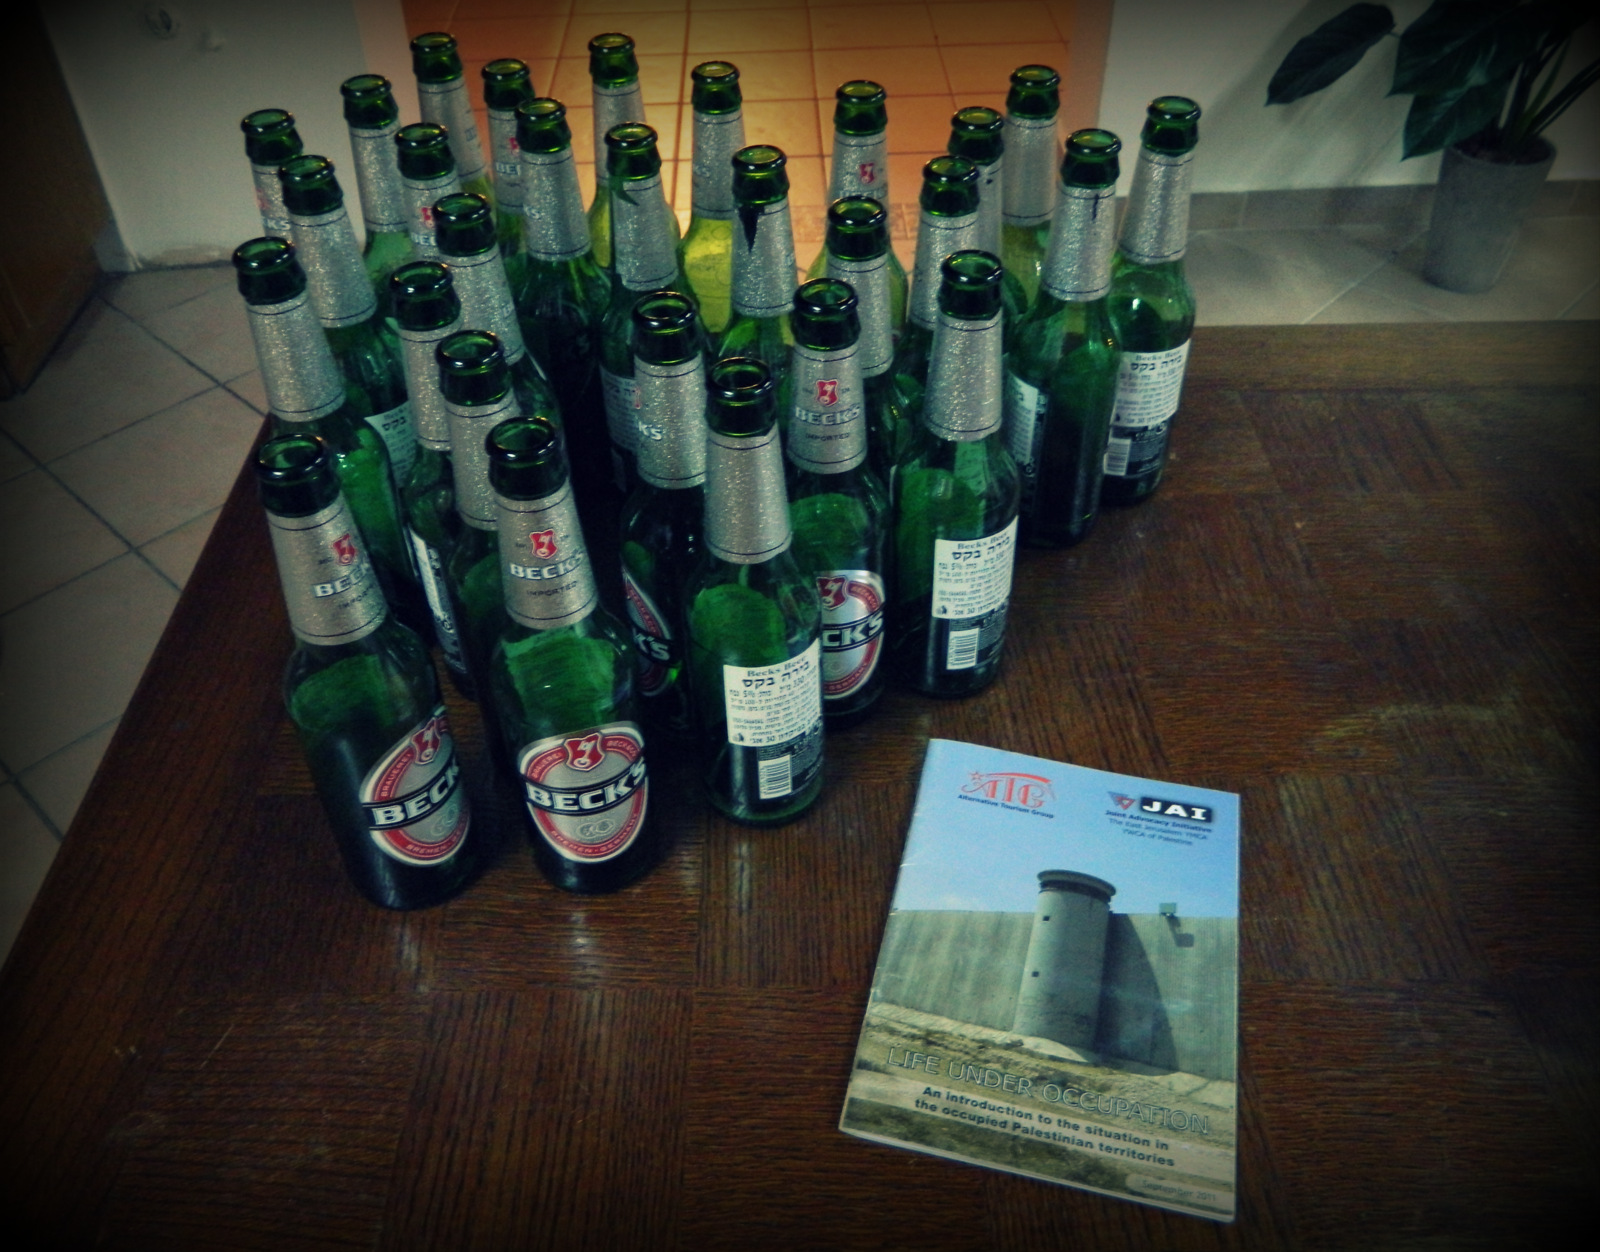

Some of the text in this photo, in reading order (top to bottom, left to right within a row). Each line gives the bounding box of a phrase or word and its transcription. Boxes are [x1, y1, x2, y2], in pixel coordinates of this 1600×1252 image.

[1130, 362, 1156, 373] בקס
[638, 421, 662, 441] K'S
[951, 535, 1011, 562] בירה בקס
[957, 542, 987, 550] Becks
[509, 546, 585, 580] BECK'S
[526, 580, 578, 597] IMPORTED
[821, 611, 885, 648] CK'S
[631, 627, 671, 661] K'S
[742, 661, 809, 690] בירה בקס
[747, 668, 780, 677] Becks
[380, 752, 411, 797] BRAUEREI
[525, 756, 647, 811] BECK'S
[371, 755, 460, 826] BECK
[957, 794, 1054, 819] Alternative Tourism Group
[1141, 800, 1207, 821] JAI
[1105, 810, 1212, 833] Joint Advocacy Initiative
[1125, 821, 1141, 829] East
[1144, 825, 1182, 837] Jerusalem
[1185, 832, 1207, 841] YMCA
[1147, 831, 1156, 839] of
[1157, 835, 1193, 845] Palestine
[888, 1047, 1209, 1135] LIFE UNDER OCCUPATION
[922, 1086, 1169, 1151] An introduction to the situation in
[915, 1098, 1175, 1167] the occupied Palestinian territories
[1142, 1180, 1194, 1198] September
